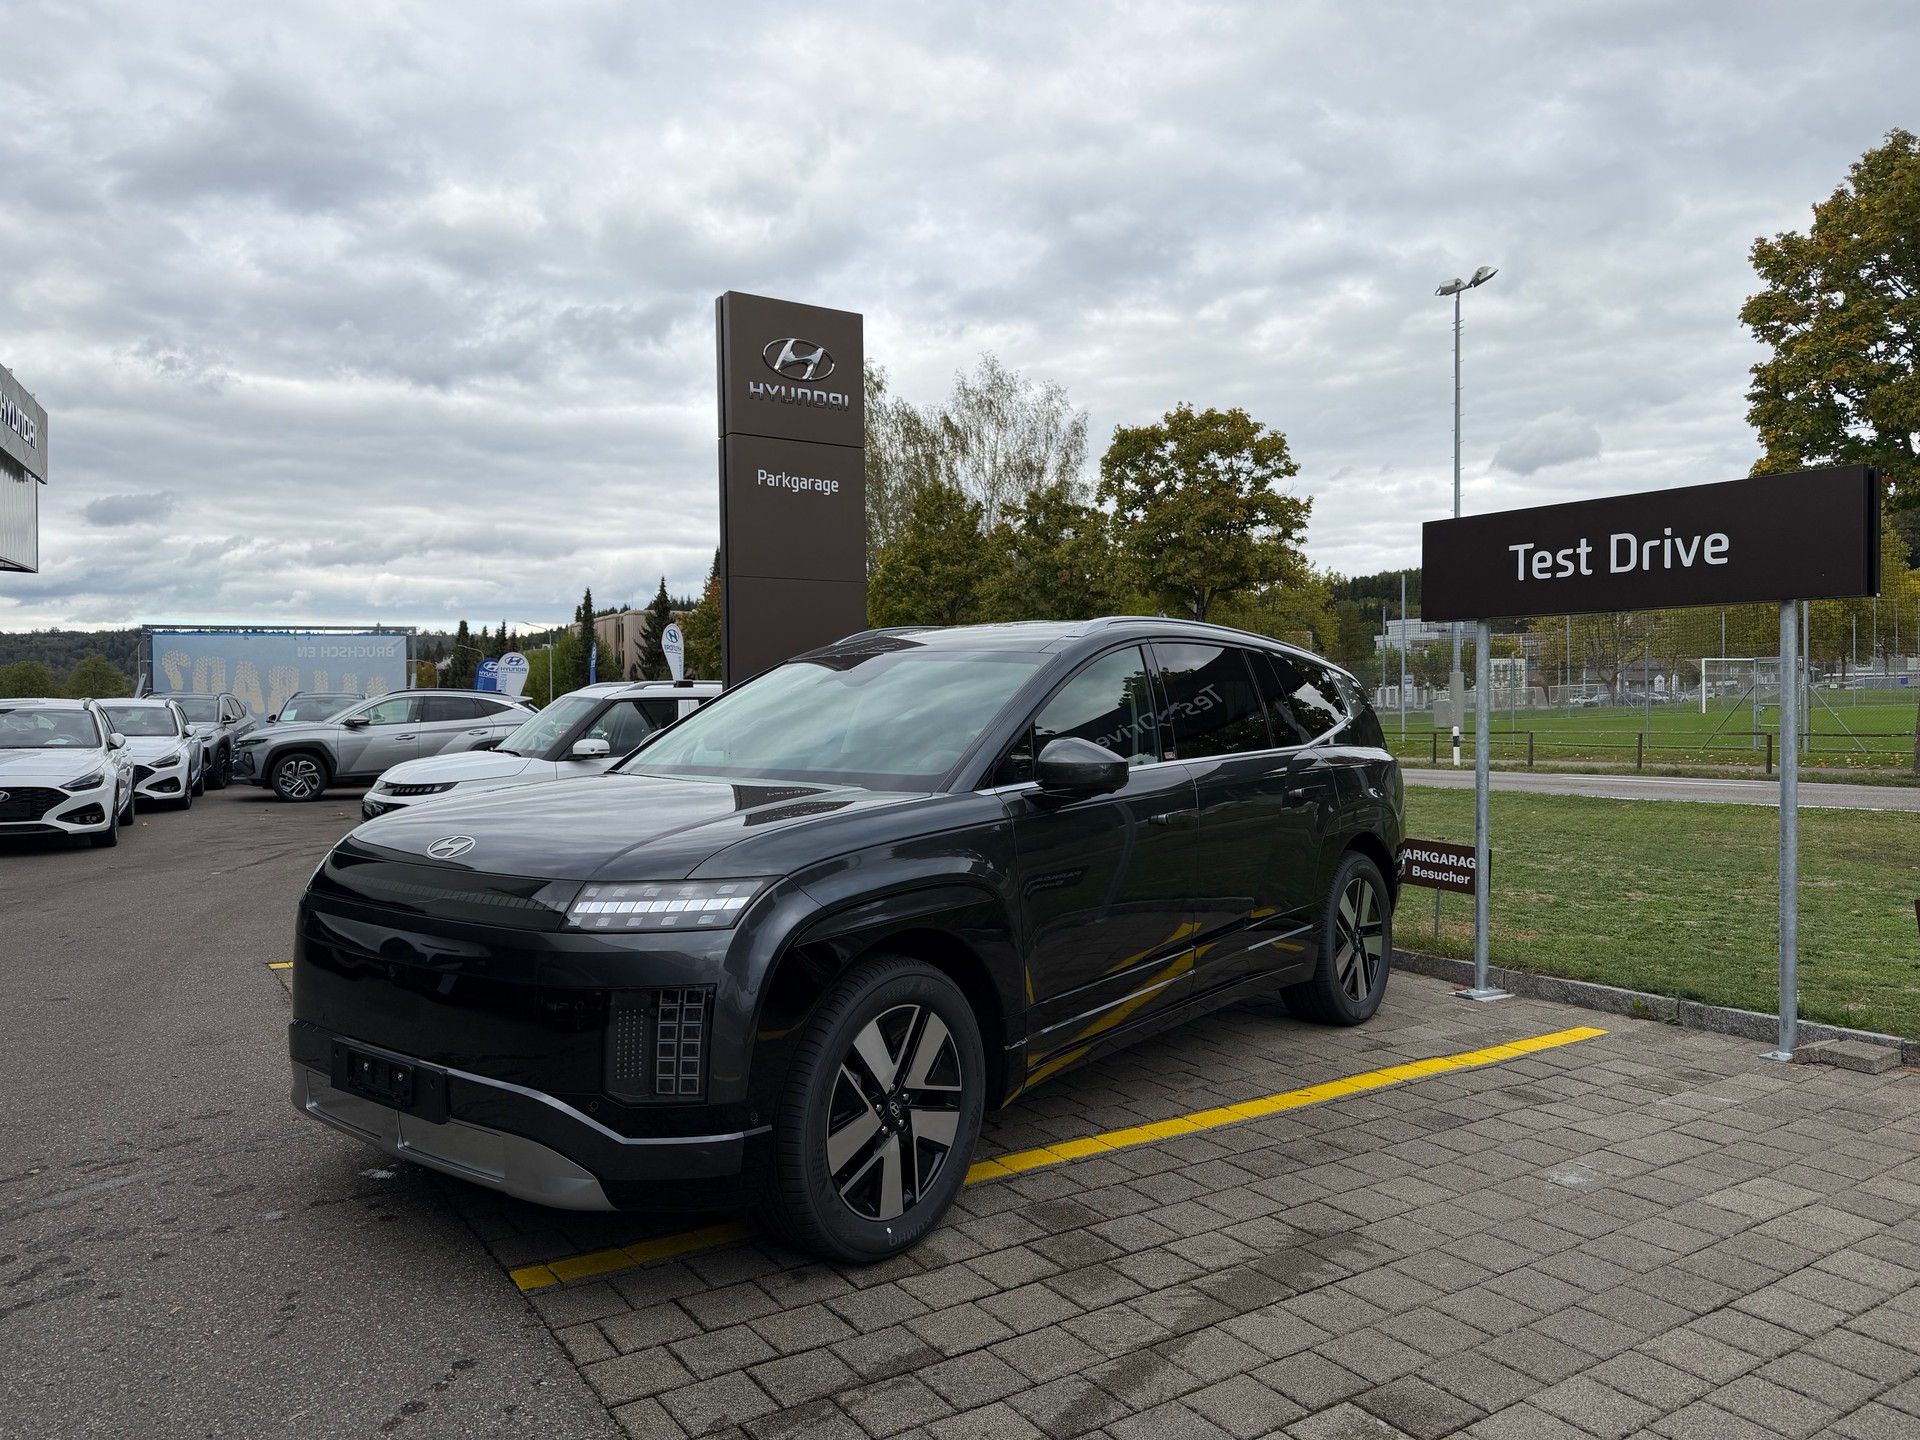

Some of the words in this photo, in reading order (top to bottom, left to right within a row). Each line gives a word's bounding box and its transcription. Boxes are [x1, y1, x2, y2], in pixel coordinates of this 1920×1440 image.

[748, 381, 850, 411] HYUNDAI
[0, 391, 37, 449] HYUNDAI
[757, 468, 840, 496] Parkgarage
[1508, 538, 1593, 581] Test
[1609, 527, 1730, 574] Drive
[1411, 865, 1471, 885] Besucher
[888, 1215, 933, 1247] KUMHO
